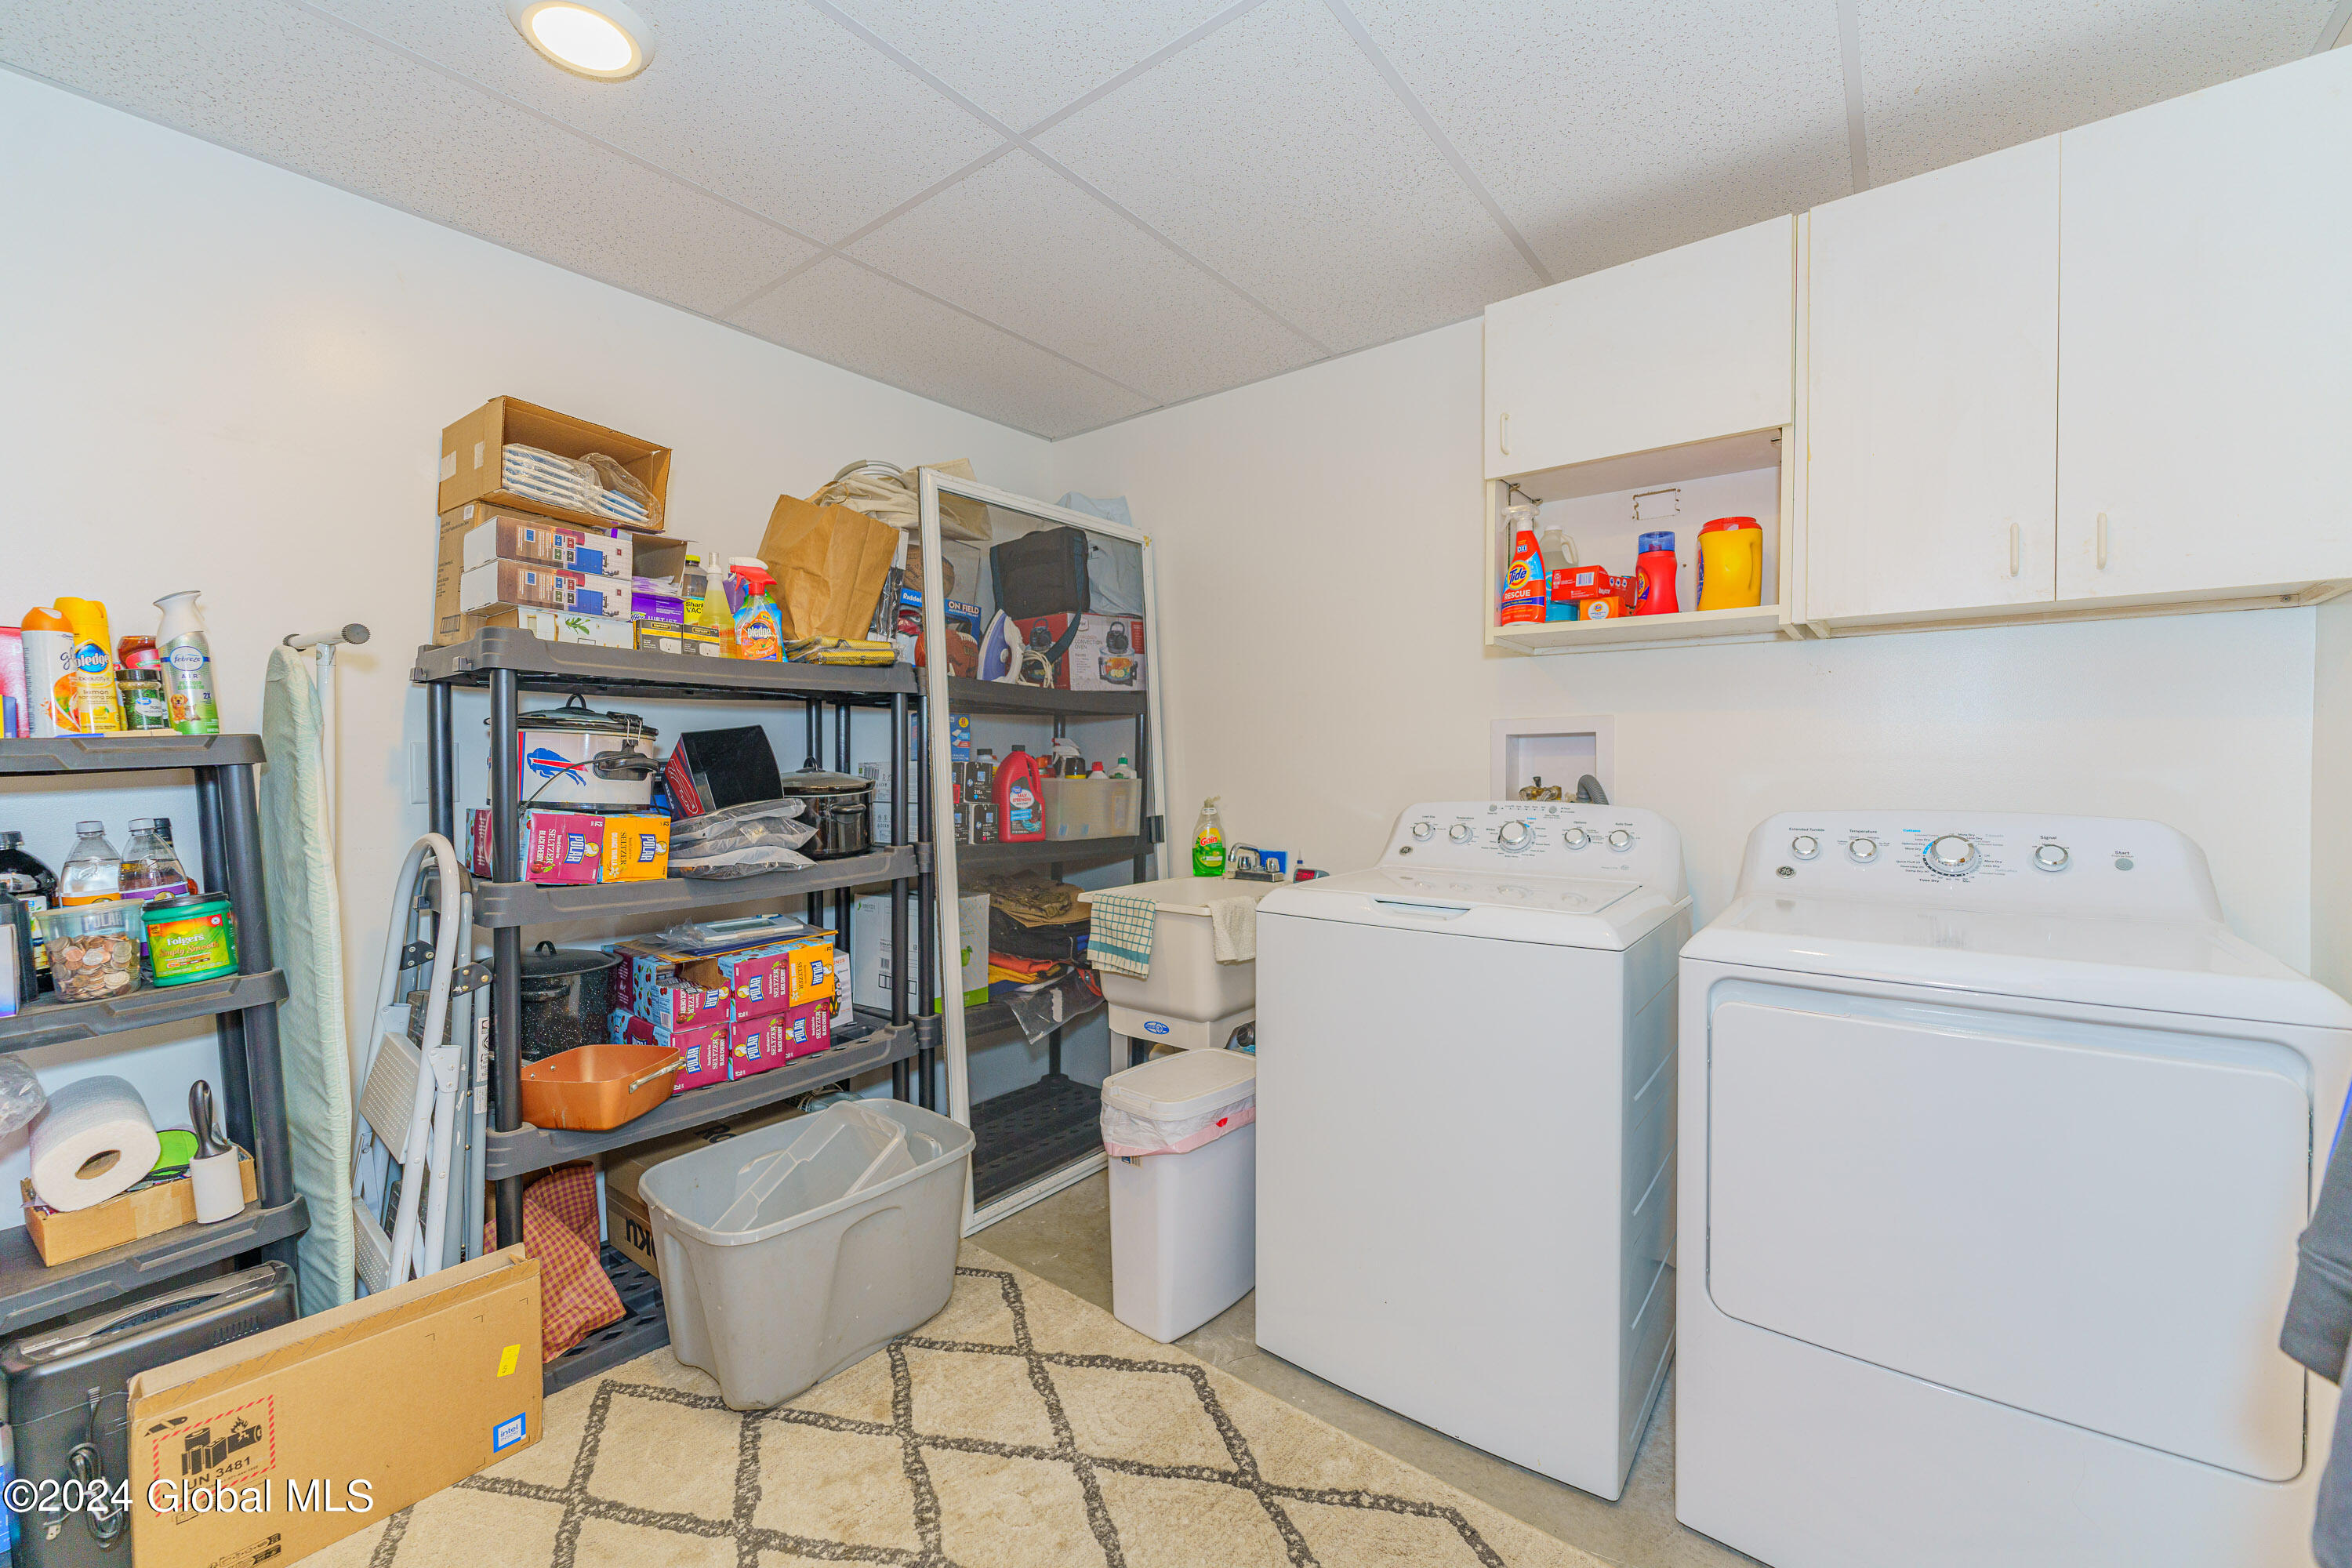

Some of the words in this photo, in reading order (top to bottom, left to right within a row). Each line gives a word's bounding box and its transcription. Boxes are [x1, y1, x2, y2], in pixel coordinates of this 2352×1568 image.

[1517, 544, 1527, 553] OXI
[1508, 566, 1527, 585] Tide
[902, 593, 922, 603] Riddel
[1504, 590, 1531, 600] RESCUE
[948, 601, 961, 610] ON
[962, 603, 979, 614] FIELD
[747, 626, 771, 639] pledge
[174, 652, 201, 663] febreze
[546, 828, 557, 864] SELTZER
[566, 835, 584, 863] POLAR
[640, 836, 655, 862] POLAR
[1200, 835, 1218, 847] Gain
[536, 845, 546, 862] CHERRY
[167, 934, 205, 946] Folgers
[159, 947, 185, 958] Simply
[187, 941, 220, 954] Smooth
[811, 961, 824, 985] POLAR
[750, 976, 763, 1002] POLAR
[705, 989, 719, 1008] OLAR
[794, 1018, 807, 1044] POLAR
[747, 1034, 760, 1061] POLAR
[688, 1047, 700, 1073] POLAR
[500, 1424, 518, 1437] intel
[188, 1473, 209, 1490] UN
[216, 1456, 250, 1478] 3481
